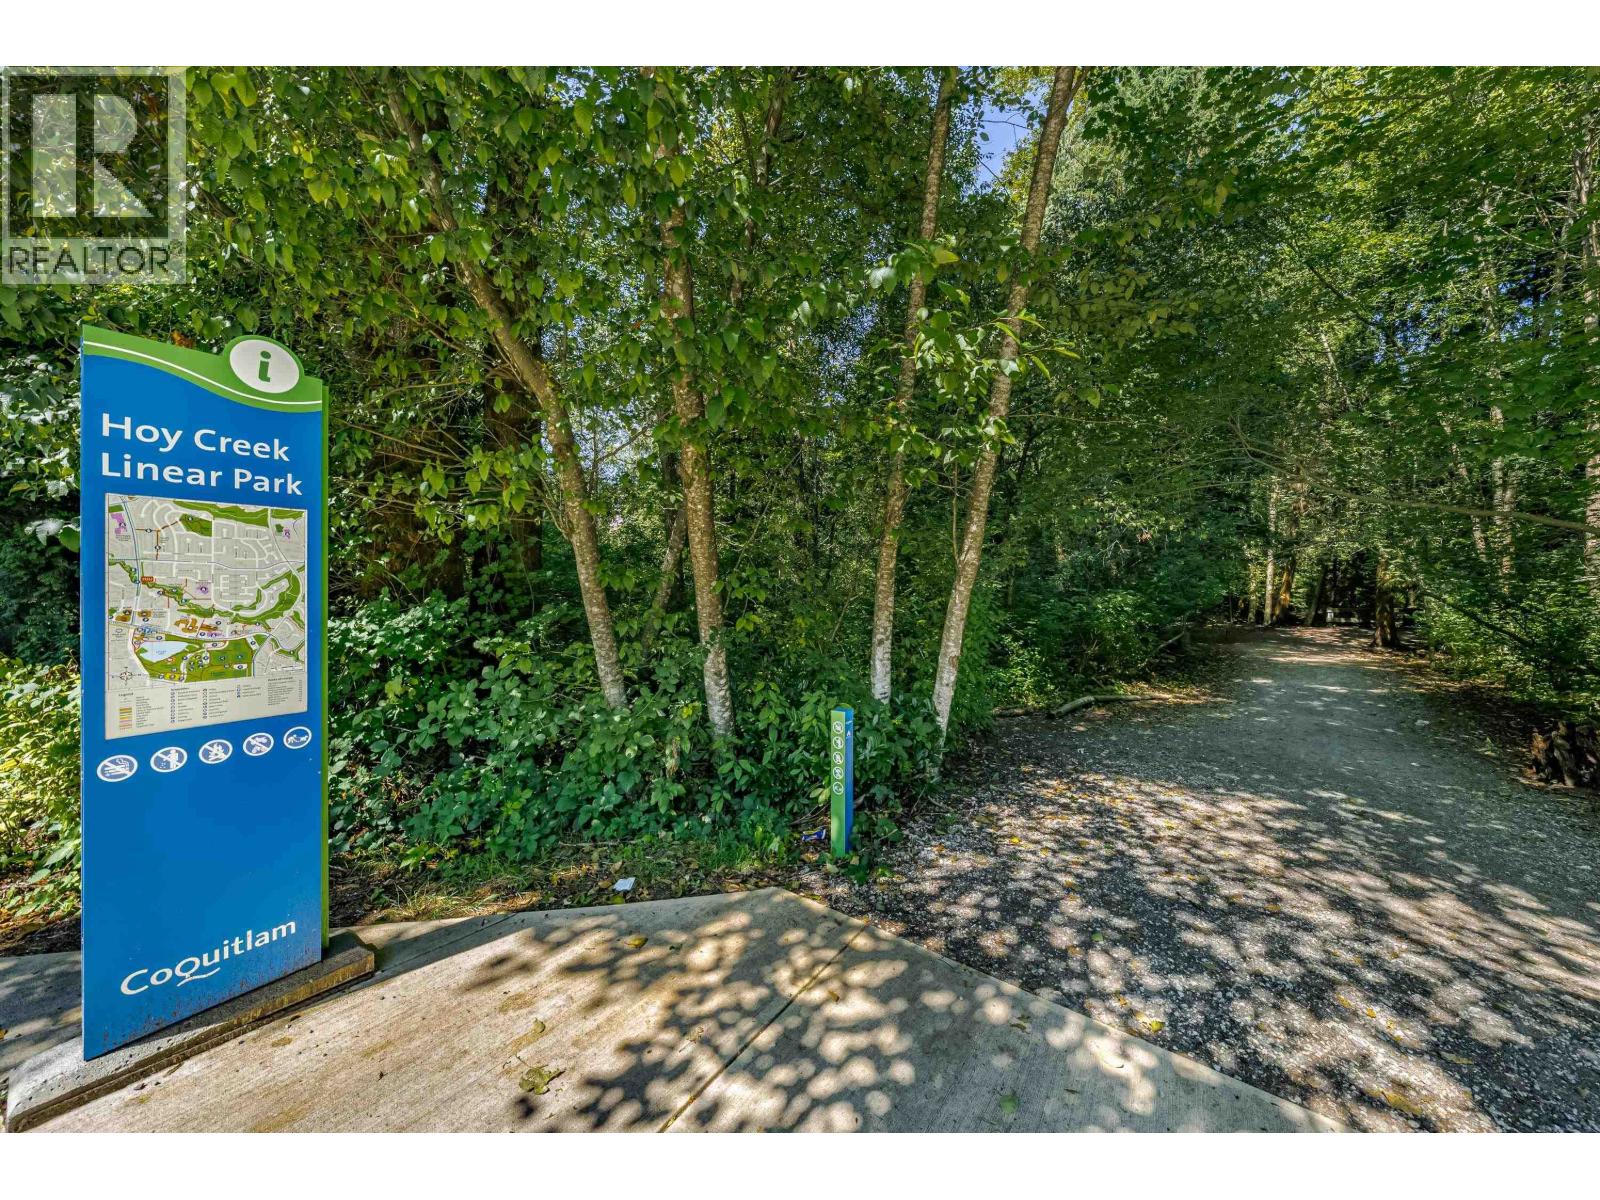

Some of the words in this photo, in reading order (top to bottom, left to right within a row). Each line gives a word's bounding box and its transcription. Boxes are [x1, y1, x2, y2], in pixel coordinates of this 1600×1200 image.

[102, 412, 183, 452] Hoy
[194, 429, 290, 462] Creek
[101, 451, 222, 487] Linear
[234, 468, 303, 496] Park
